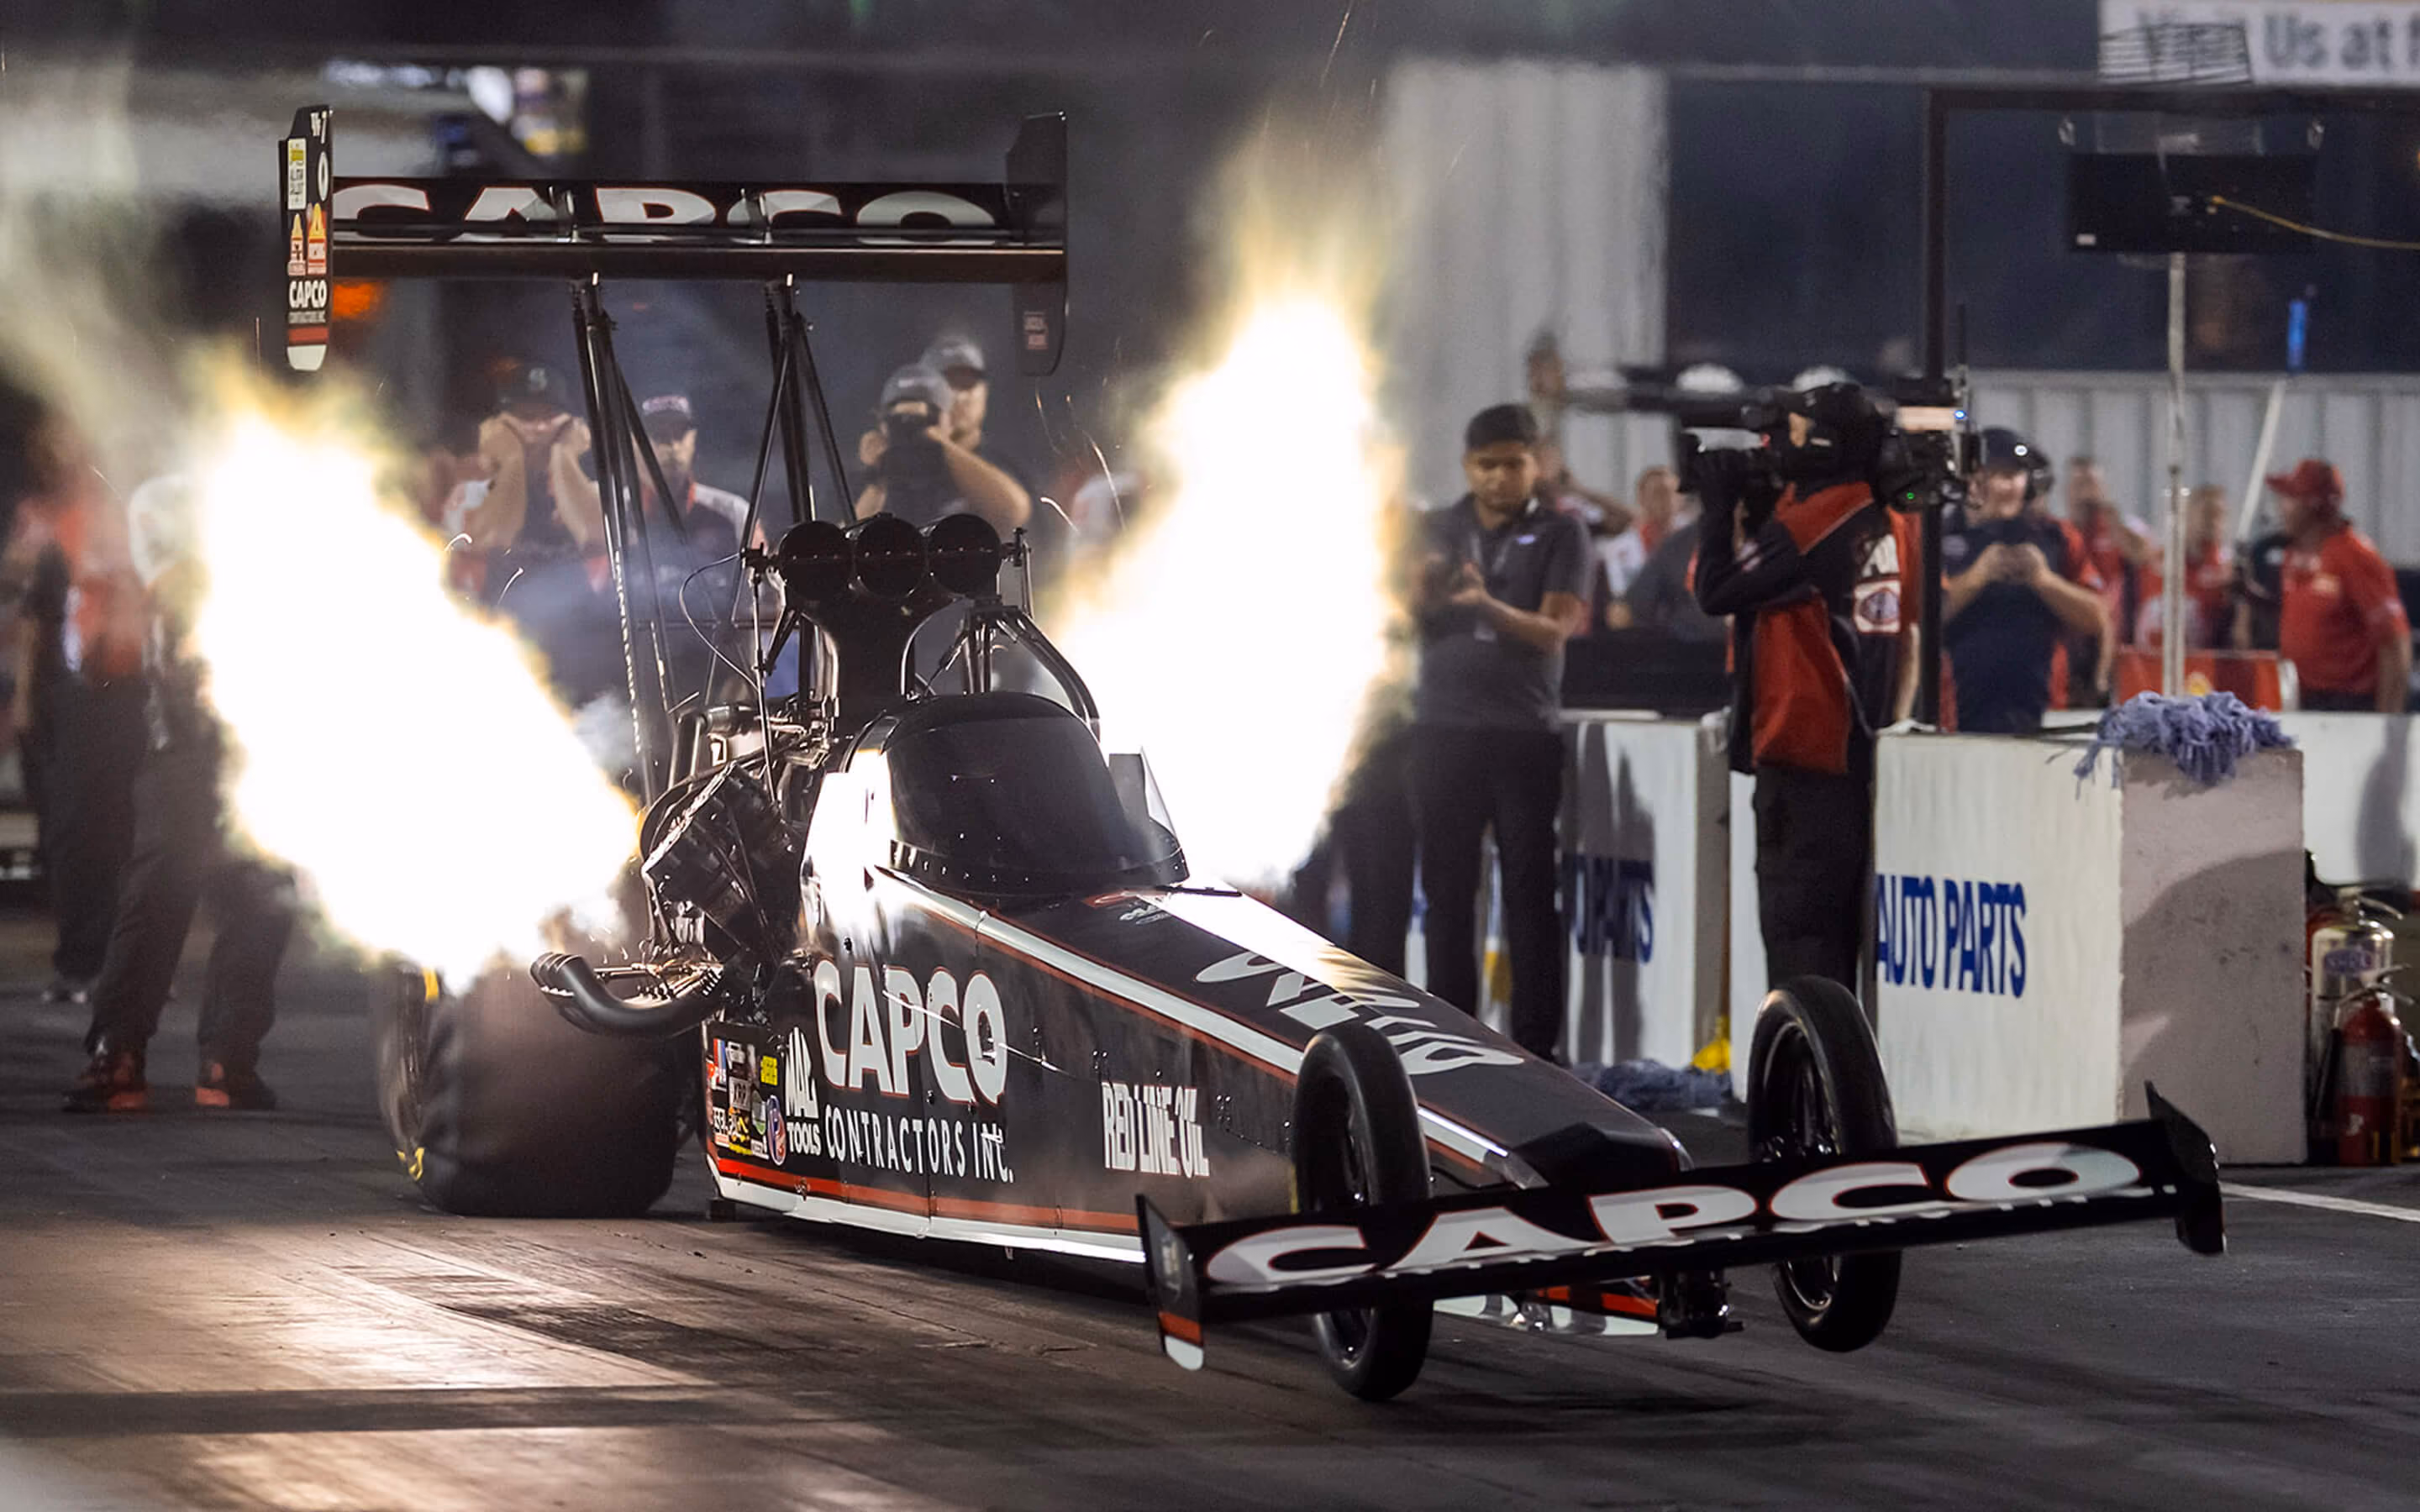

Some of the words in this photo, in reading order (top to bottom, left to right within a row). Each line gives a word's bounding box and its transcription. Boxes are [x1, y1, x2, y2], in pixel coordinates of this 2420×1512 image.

[289, 280, 328, 309] CAPCO
[1877, 874, 1937, 990] AUTO
[1944, 879, 2027, 998] PARTS
[813, 958, 1007, 1105] CAPCO
[786, 1121, 822, 1156] TOOLS
[825, 1104, 966, 1177] CONTRACTORS
[1101, 1081, 1136, 1171] RED
[1134, 1084, 1181, 1176] LINE
[1175, 1085, 1210, 1179] OIL
[1205, 1142, 2142, 1285] CAPCO
